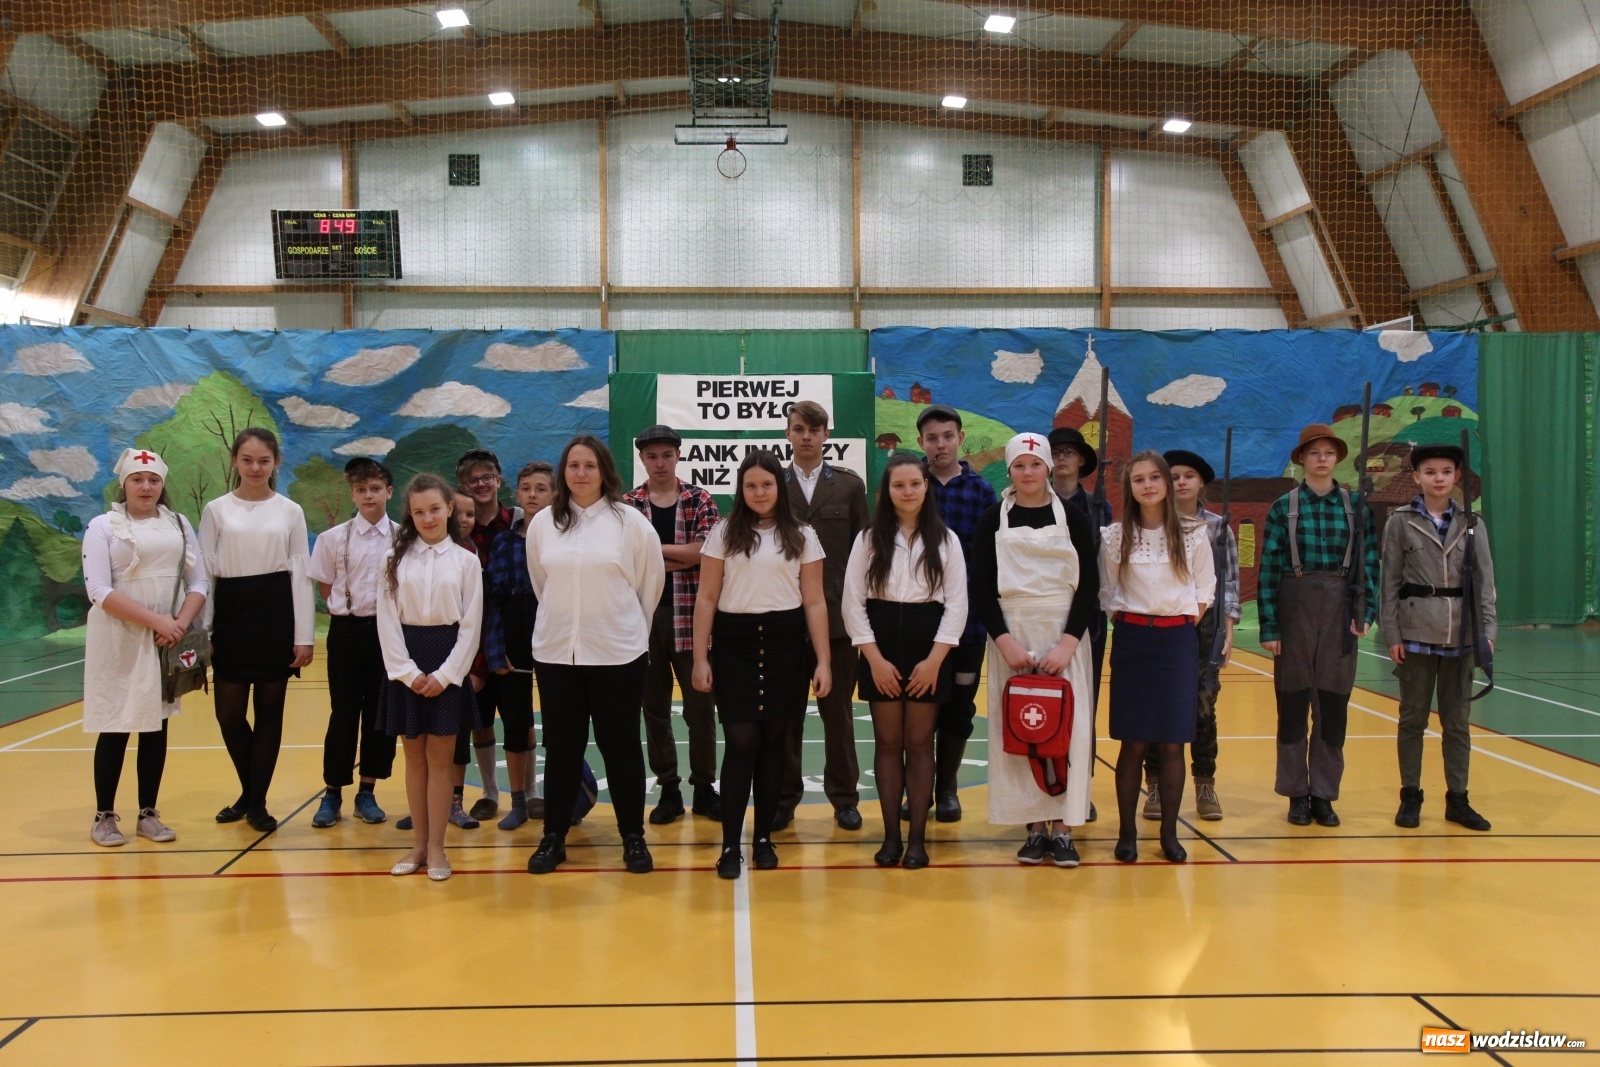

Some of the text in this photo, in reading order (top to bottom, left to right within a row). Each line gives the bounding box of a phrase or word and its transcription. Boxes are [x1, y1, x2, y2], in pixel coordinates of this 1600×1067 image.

[287, 246, 329, 255] GOSPODARZE
[354, 245, 377, 255] GOŚCIE
[697, 380, 799, 398] PIERWEJ
[697, 402, 730, 420] TO
[691, 464, 731, 485] NIŻ
